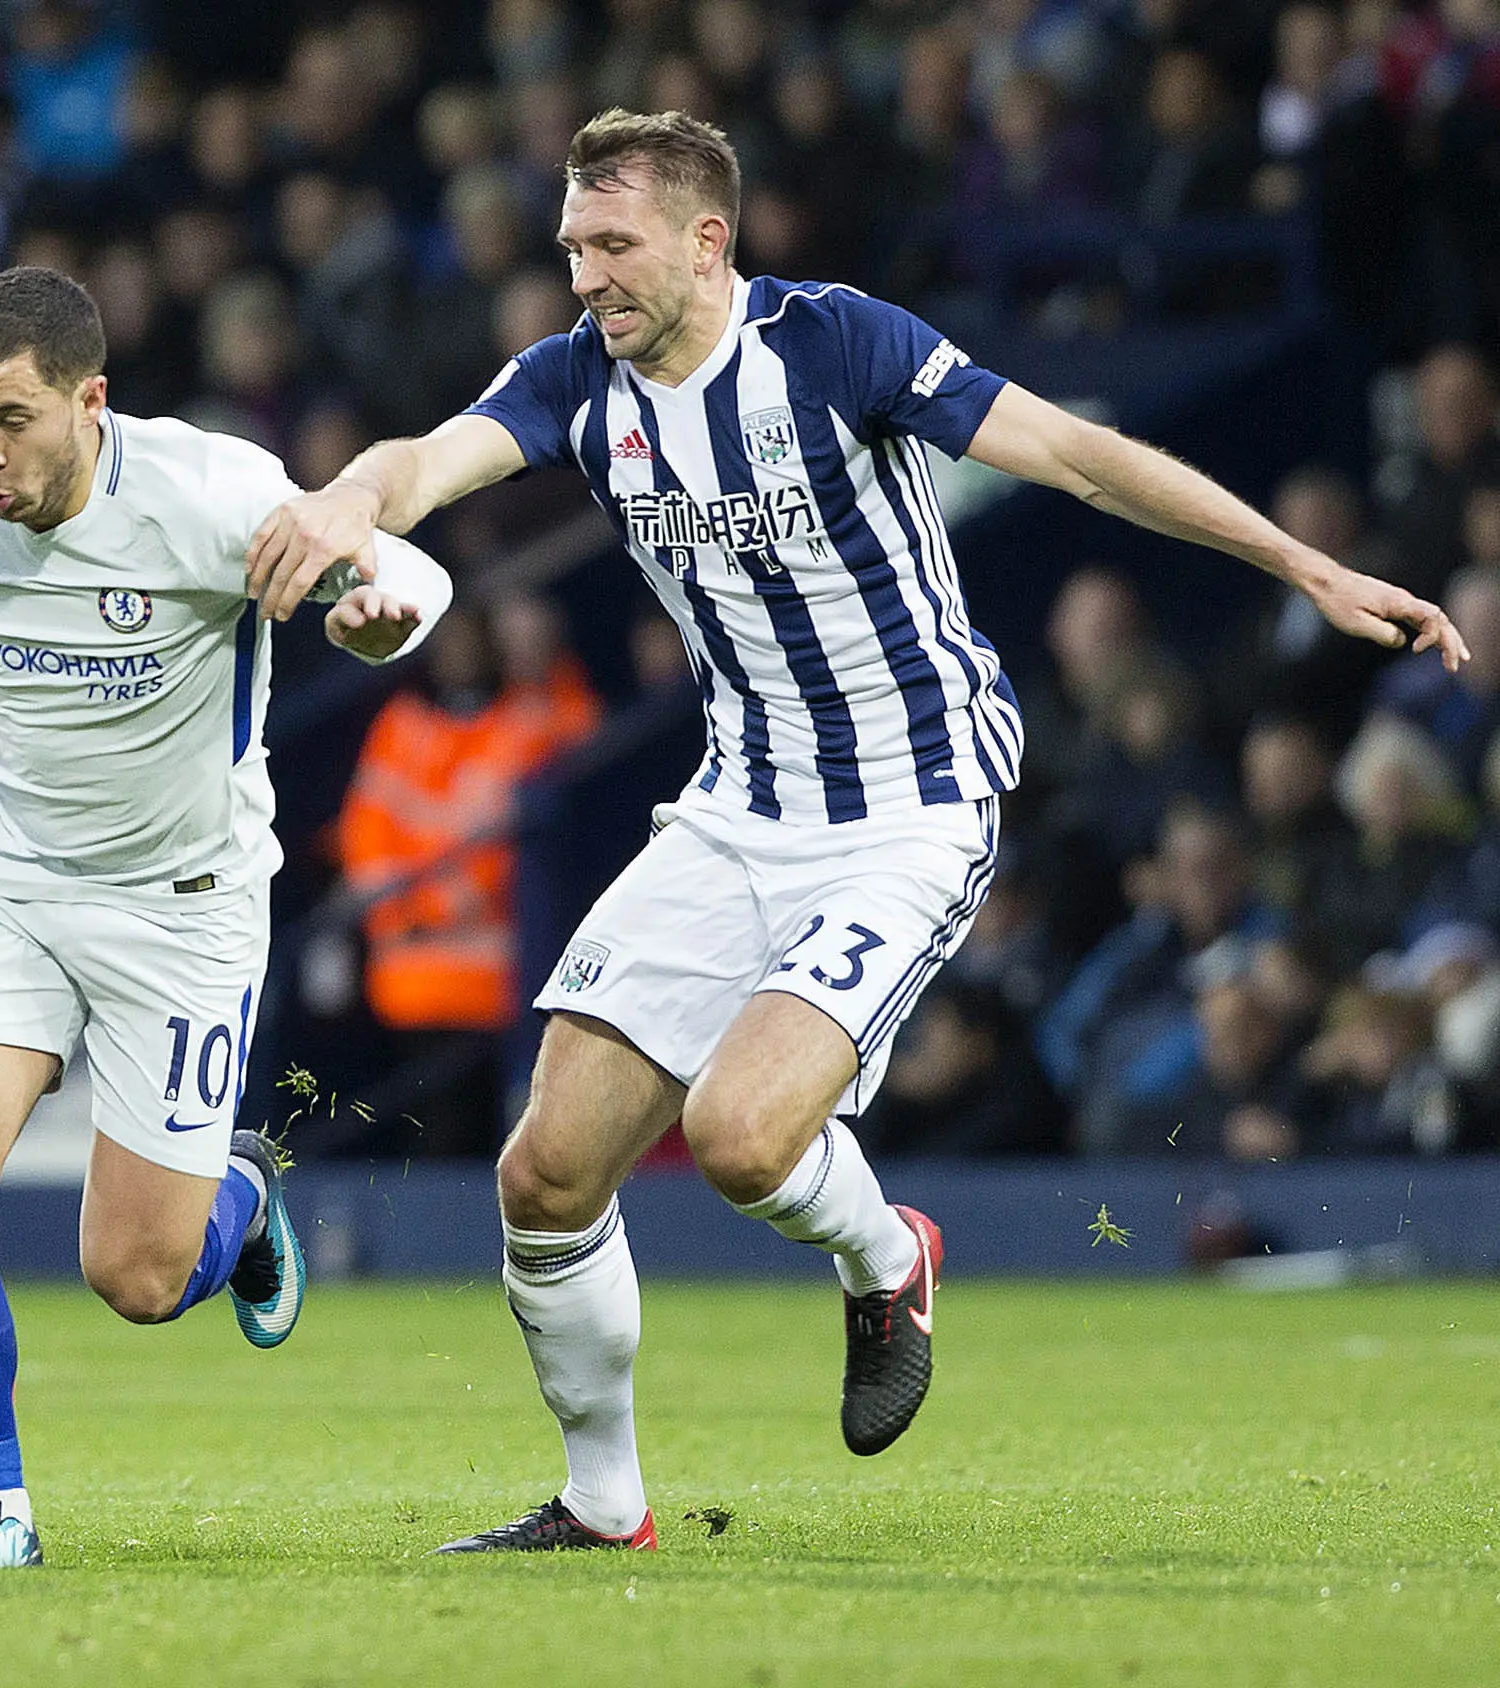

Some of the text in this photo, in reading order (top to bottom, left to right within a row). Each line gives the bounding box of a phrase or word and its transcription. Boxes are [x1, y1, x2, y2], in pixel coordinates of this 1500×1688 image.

[743, 410, 789, 430] ALBION
[609, 447, 654, 461] adidas
[672, 536, 830, 580] PALM
[87, 674, 165, 701] TYRES
[773, 914, 886, 990] 23
[164, 1016, 232, 1109] 10
